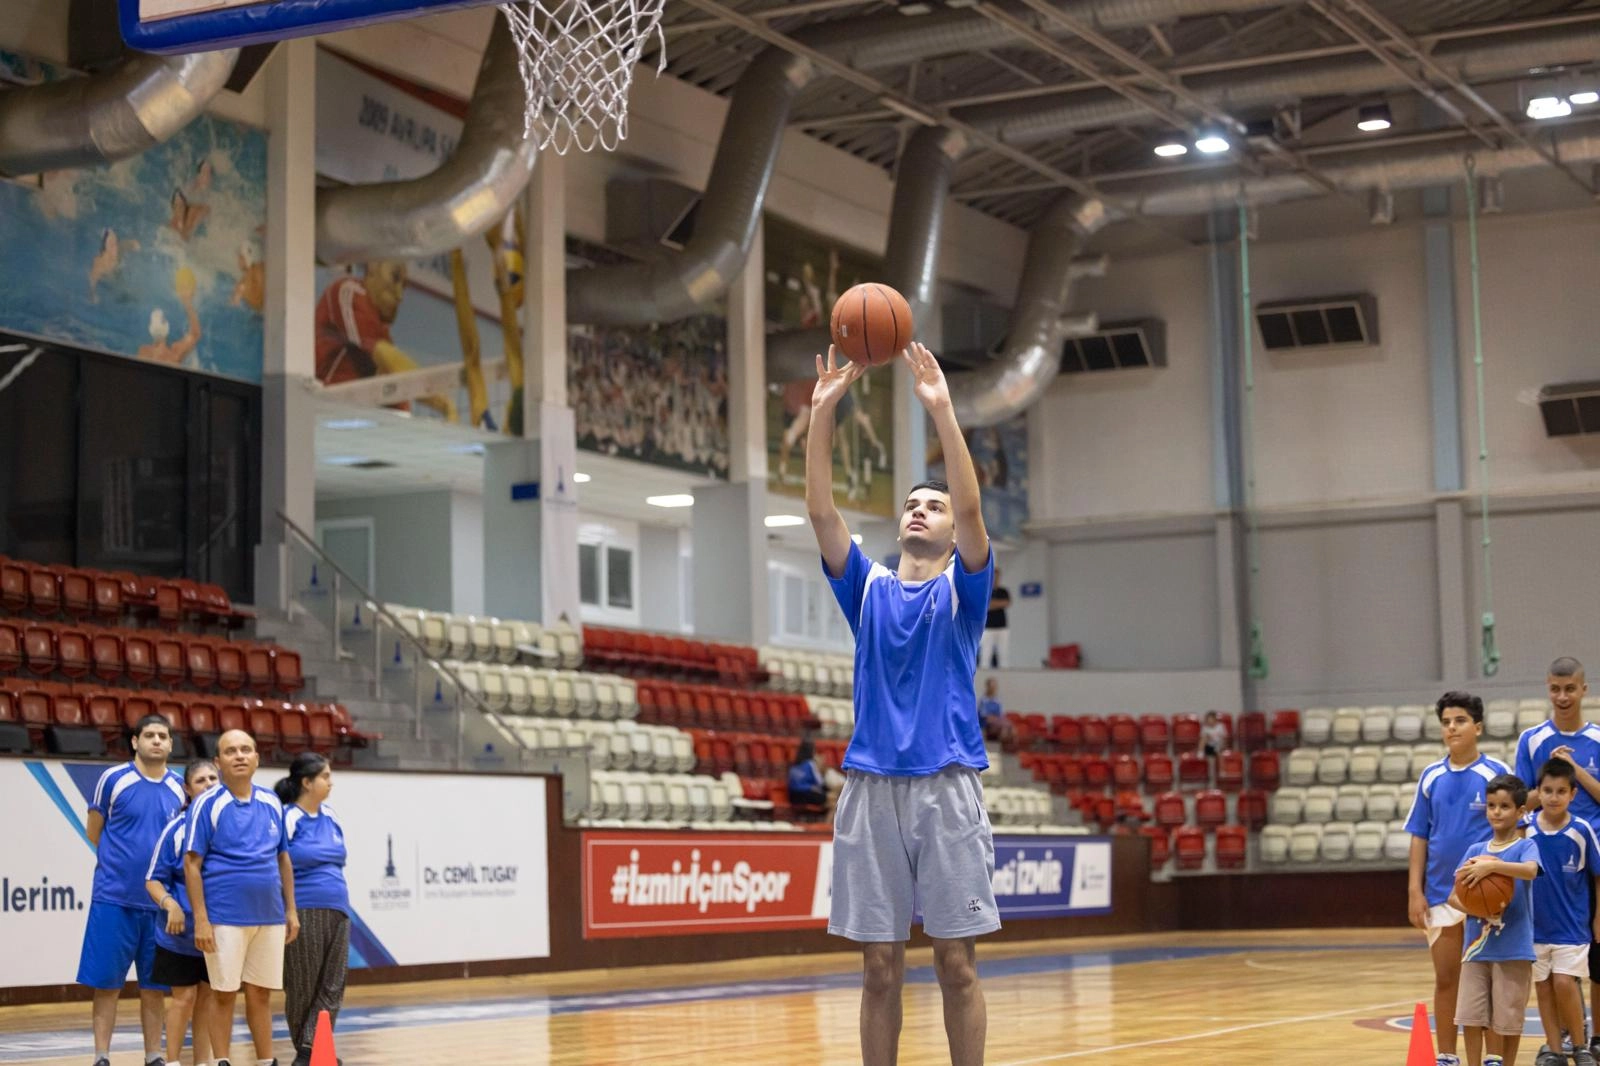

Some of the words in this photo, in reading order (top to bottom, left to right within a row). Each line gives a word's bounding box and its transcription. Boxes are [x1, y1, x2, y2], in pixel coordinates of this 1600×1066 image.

[424, 867, 440, 884] Dr.
[443, 861, 478, 884] CEMİL
[481, 866, 518, 883] TUGAY
[610, 848, 791, 913] #İzmirİçinSpor
[1016, 849, 1062, 895] İZMİR
[3, 876, 83, 912] lerim.
